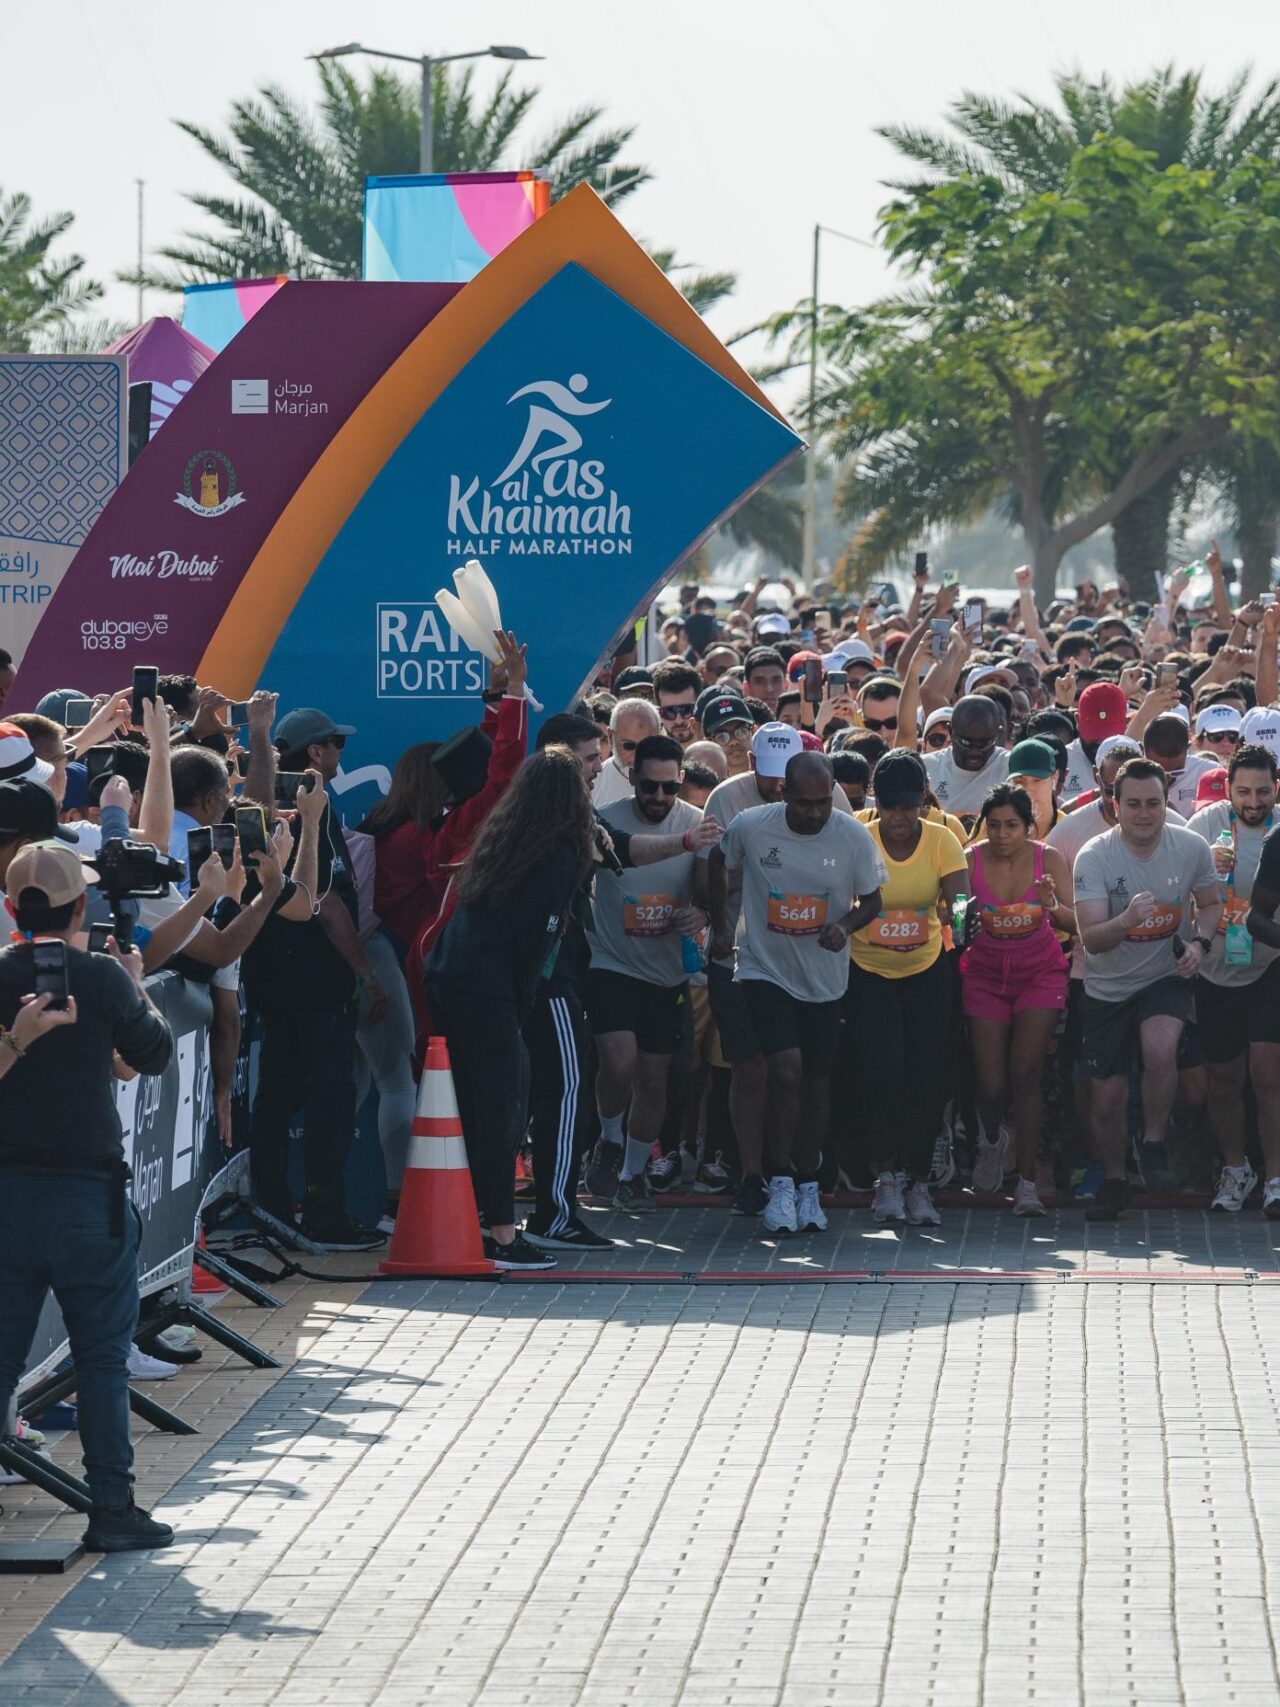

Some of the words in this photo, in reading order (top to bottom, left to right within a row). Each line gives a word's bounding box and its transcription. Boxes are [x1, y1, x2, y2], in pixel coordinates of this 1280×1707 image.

[274, 379, 313, 397] مرجان
[275, 400, 328, 417] Marjan
[502, 470, 529, 502] al
[447, 474, 632, 536] Khaimah
[447, 539, 501, 555] HALF
[508, 539, 632, 555] MARATHON
[109, 554, 156, 579] Mai
[157, 550, 219, 579] Dubai
[81, 635, 126, 650] 103.8
[381, 659, 481, 691] PORTS
[635, 904, 673, 921] 5229
[780, 905, 816, 921] 5641
[993, 914, 1032, 928] 5698
[1136, 913, 1173, 928] 699
[880, 922, 919, 937] 6282
[134, 1144, 163, 1221] Marjan
